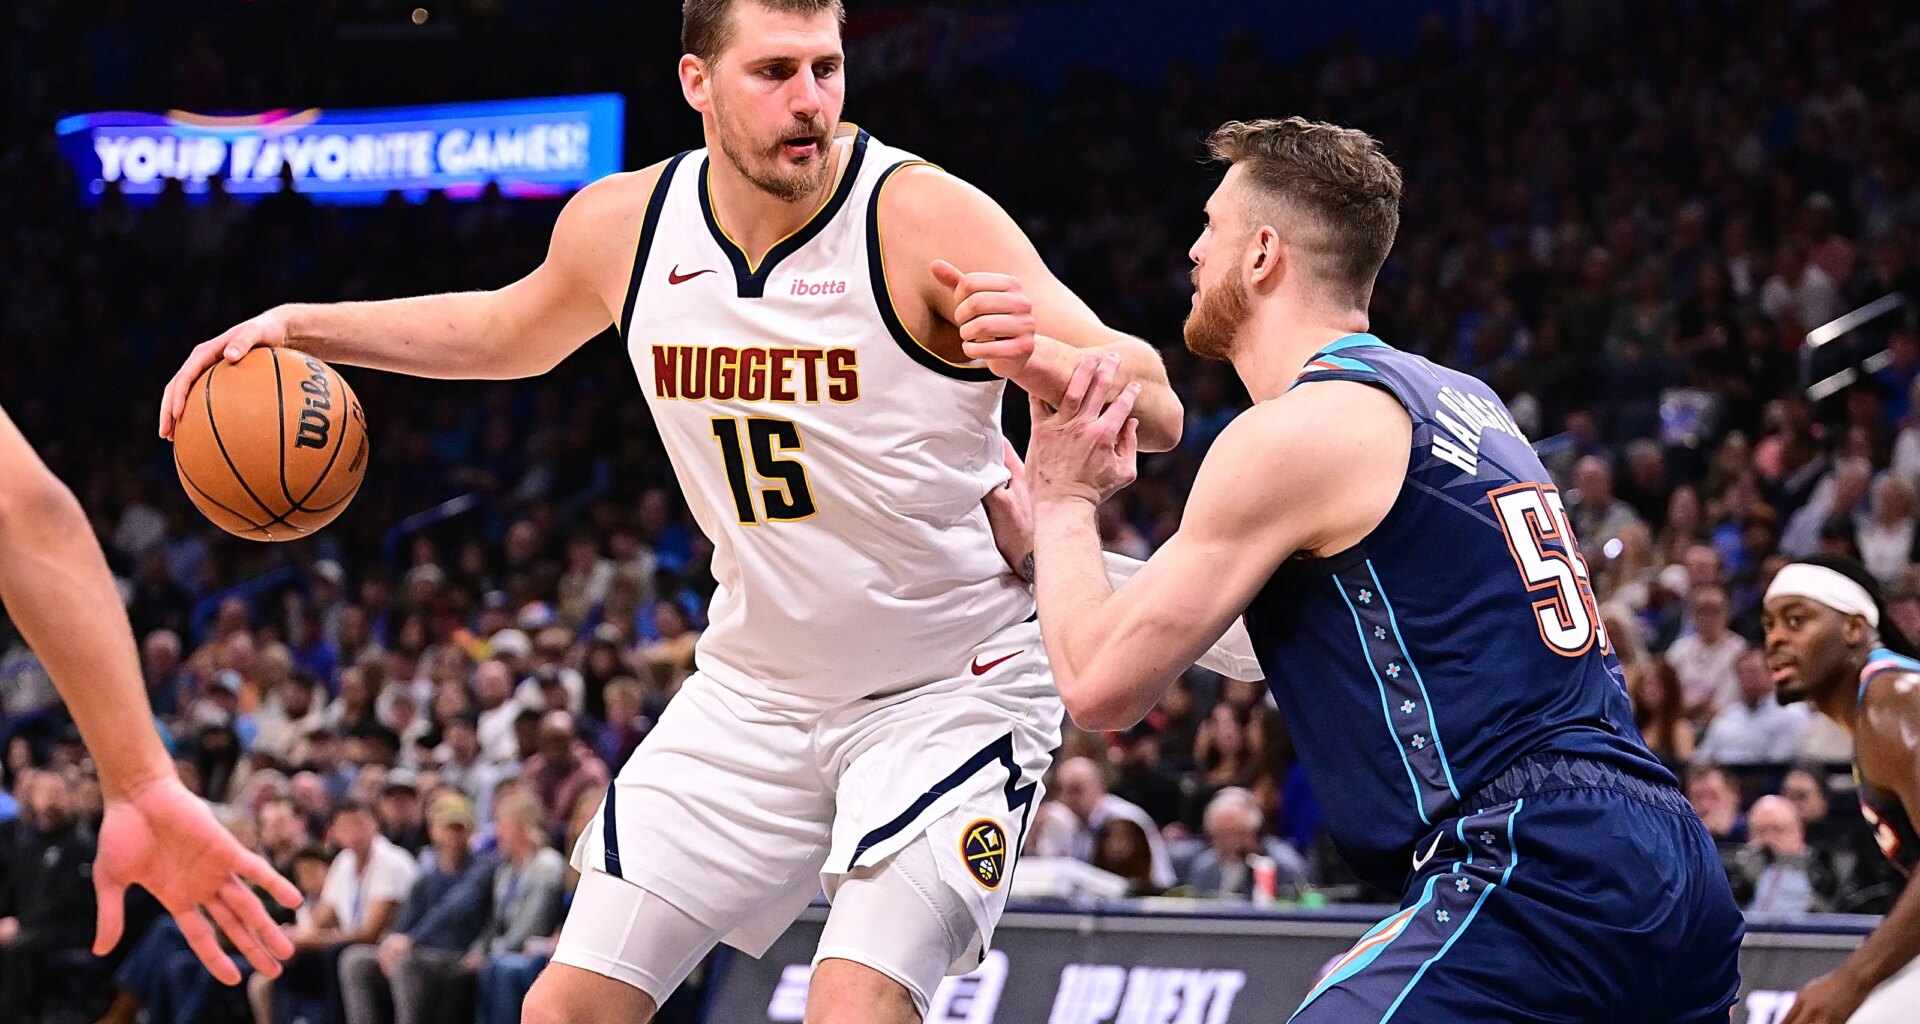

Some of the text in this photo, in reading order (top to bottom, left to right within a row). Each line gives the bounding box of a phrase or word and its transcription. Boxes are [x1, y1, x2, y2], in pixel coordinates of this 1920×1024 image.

[790, 279, 847, 297] ibotta
[651, 344, 861, 405] NUGGETS
[709, 415, 820, 527] 15
